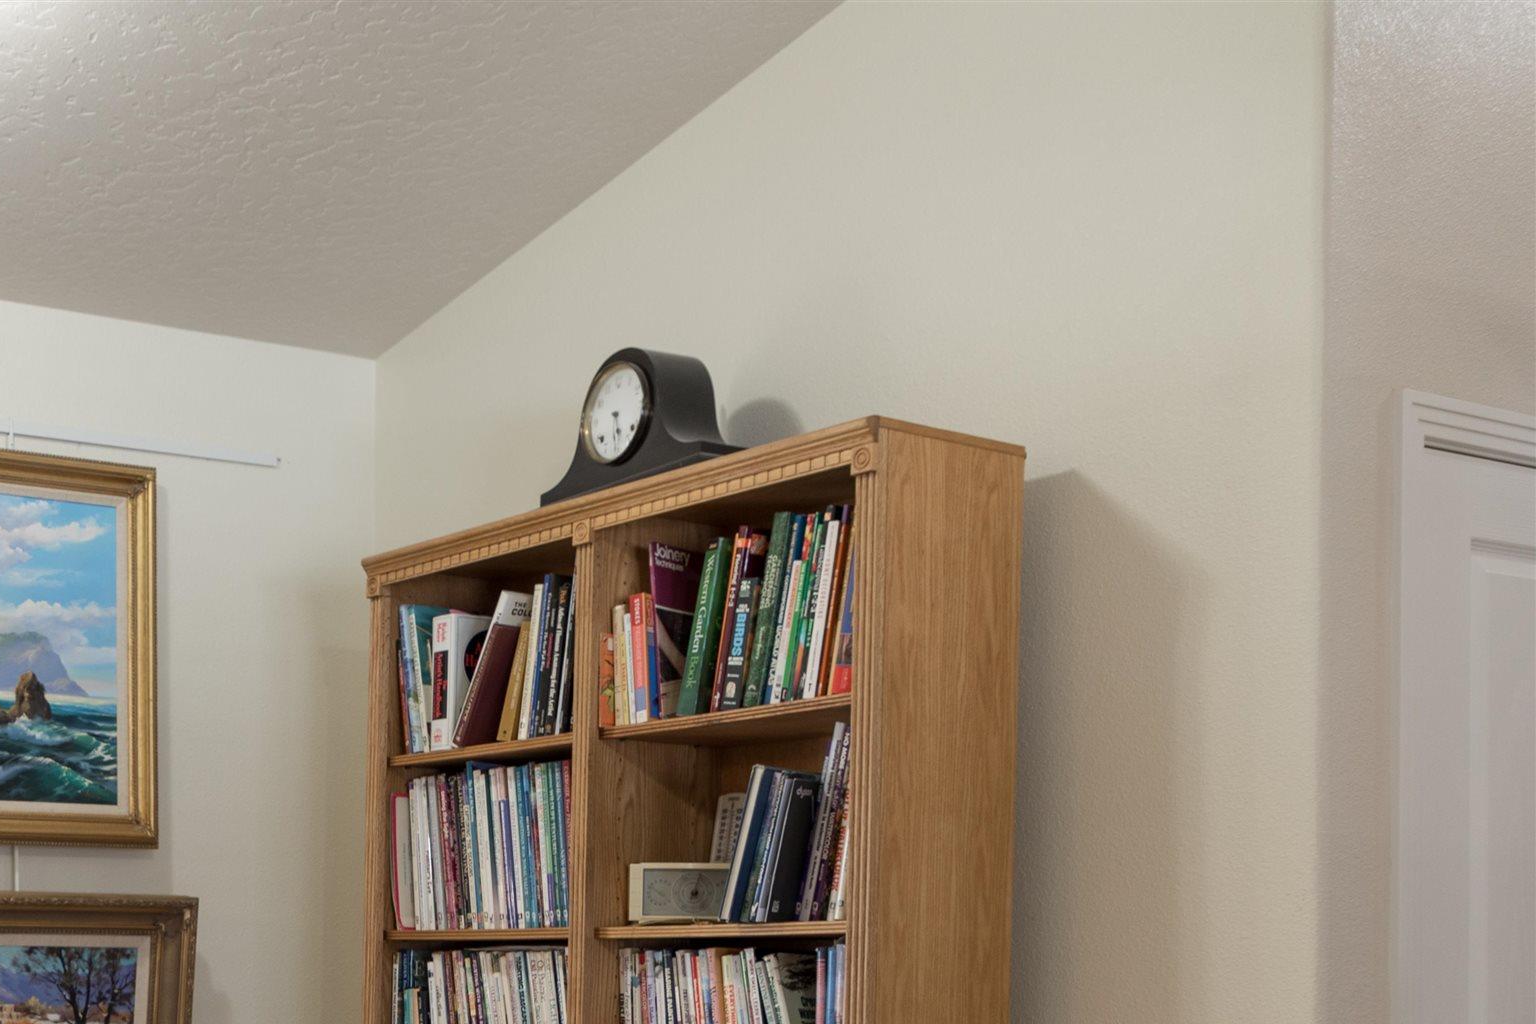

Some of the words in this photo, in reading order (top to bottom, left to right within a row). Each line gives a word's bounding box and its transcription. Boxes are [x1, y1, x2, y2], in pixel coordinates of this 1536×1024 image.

[654, 543, 691, 565] Joinery
[655, 558, 684, 572] Techniques
[699, 552, 715, 605] Western
[758, 554, 772, 610] TECHNIQUES
[764, 553, 777, 608] GARDENING
[691, 604, 707, 654] Garden
[730, 611, 747, 657] BIRDS
[772, 624, 782, 657] WORLD
[435, 652, 443, 678] Artist's
[550, 651, 559, 679] Anatomy
[685, 654, 698, 690] Book
[767, 657, 778, 686] ATLAS
[434, 679, 442, 717] Handbook
[842, 731, 850, 746] NO
[838, 746, 848, 769] MORE
[821, 810, 836, 860] WATERCOLOR
[515, 956, 524, 989] PAINTING
[664, 967, 672, 997] MARINE
